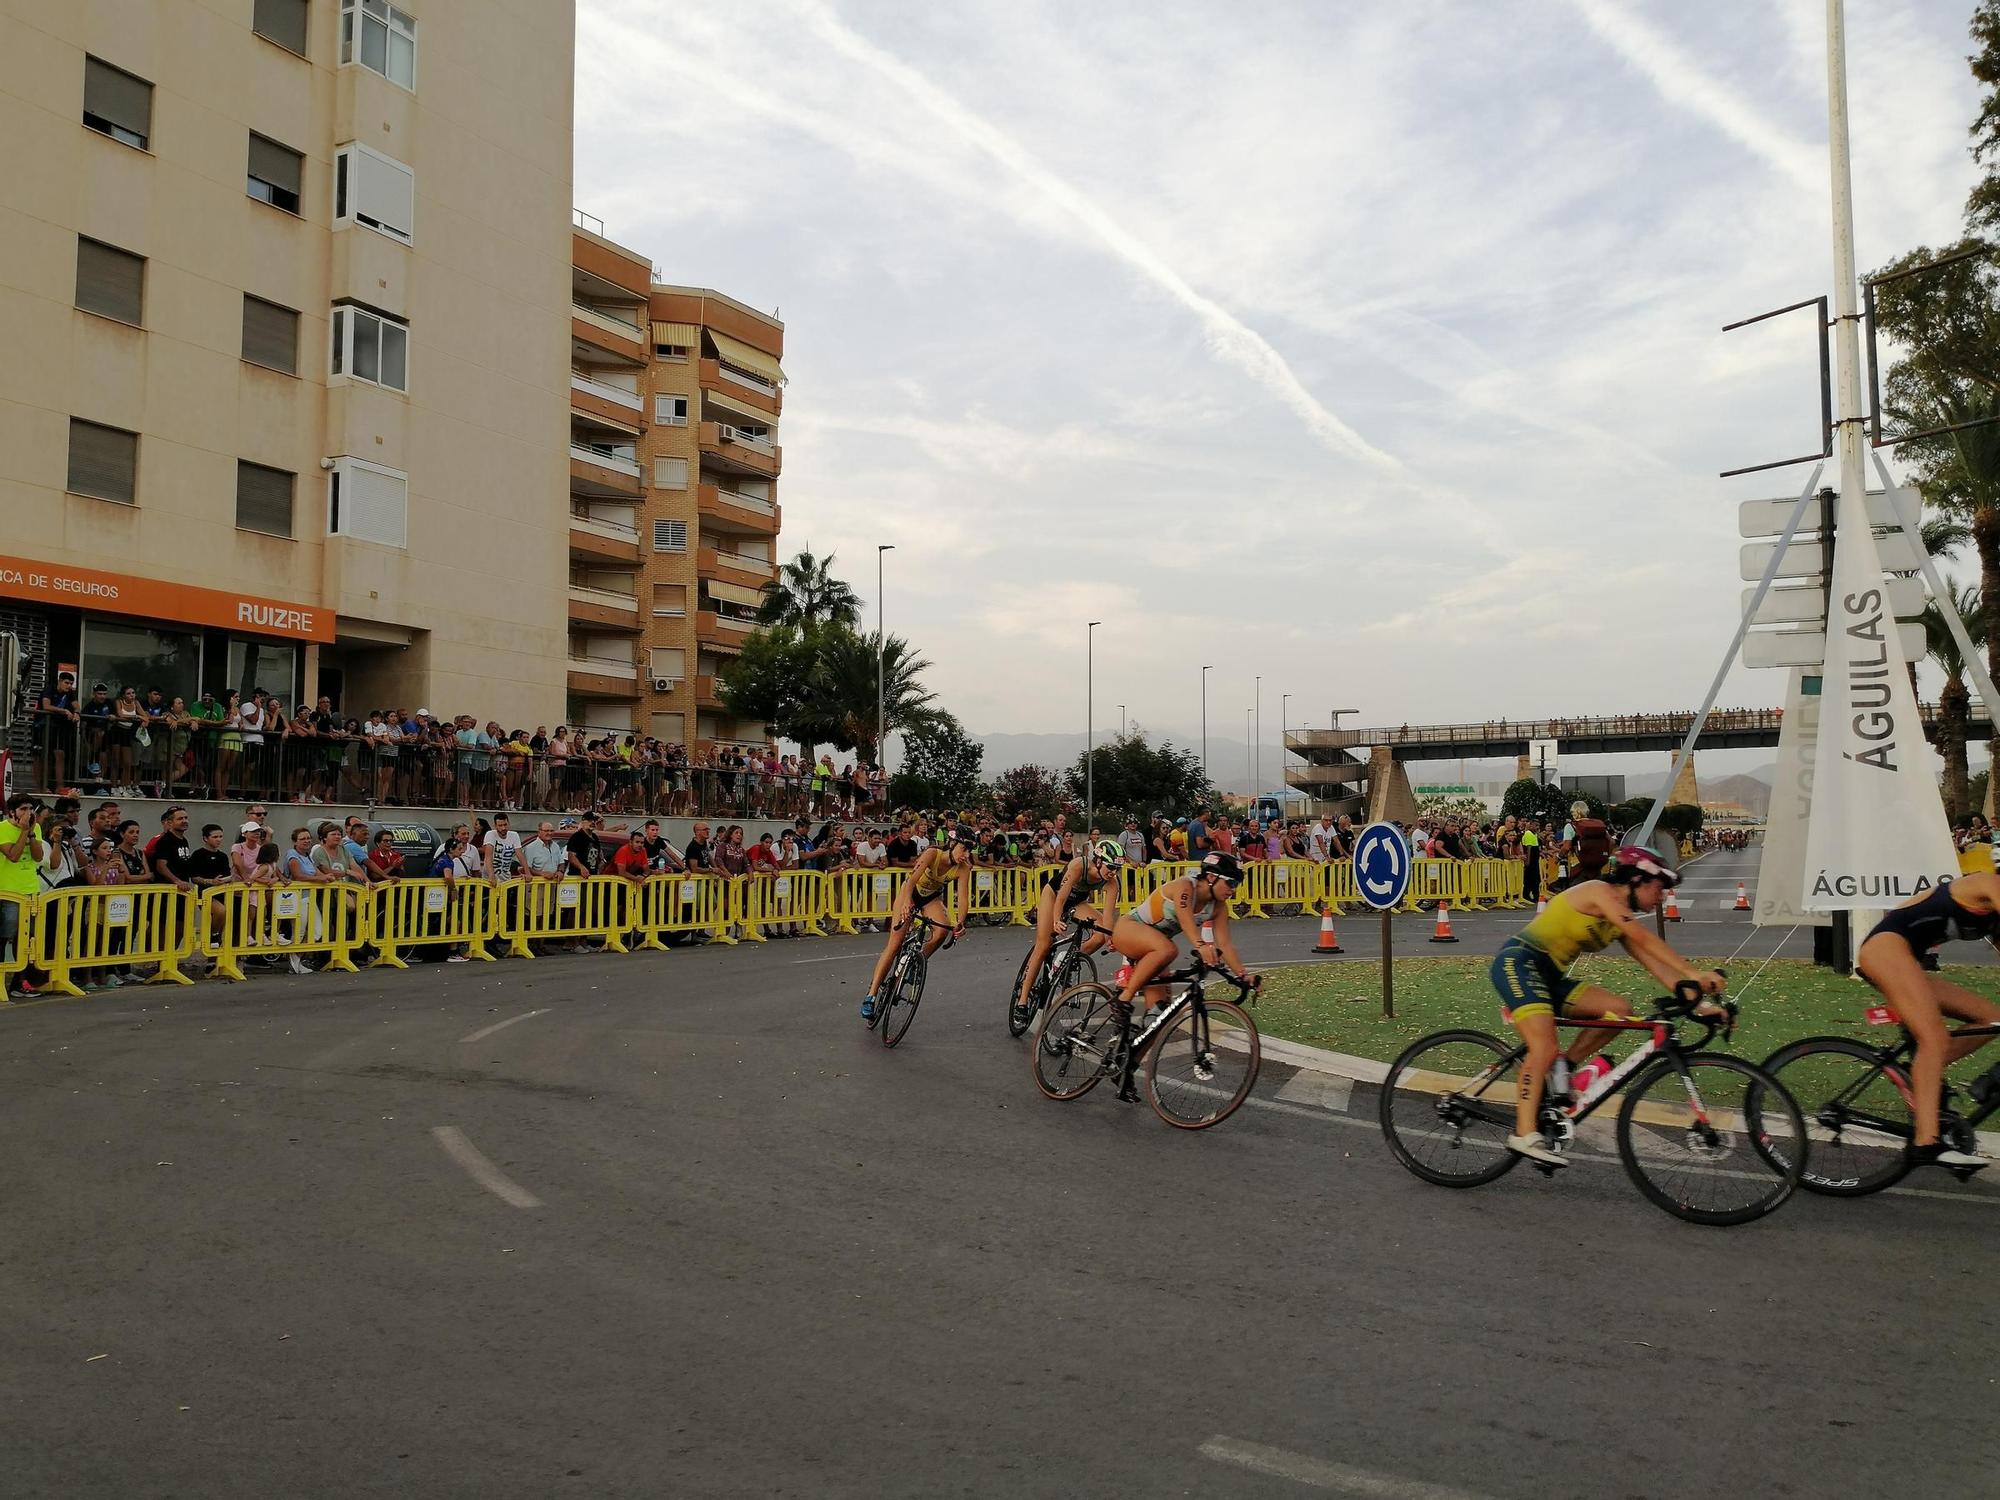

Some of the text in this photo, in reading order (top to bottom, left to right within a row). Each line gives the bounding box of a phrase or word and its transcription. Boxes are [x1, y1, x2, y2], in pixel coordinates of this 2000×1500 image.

[29, 573, 48, 588] DE
[53, 577, 119, 599] SEGUROS
[238, 602, 313, 632] RUIZRE
[1843, 589, 1898, 772] ÁGUILAS
[1800, 1171, 1860, 1187] SPEE
